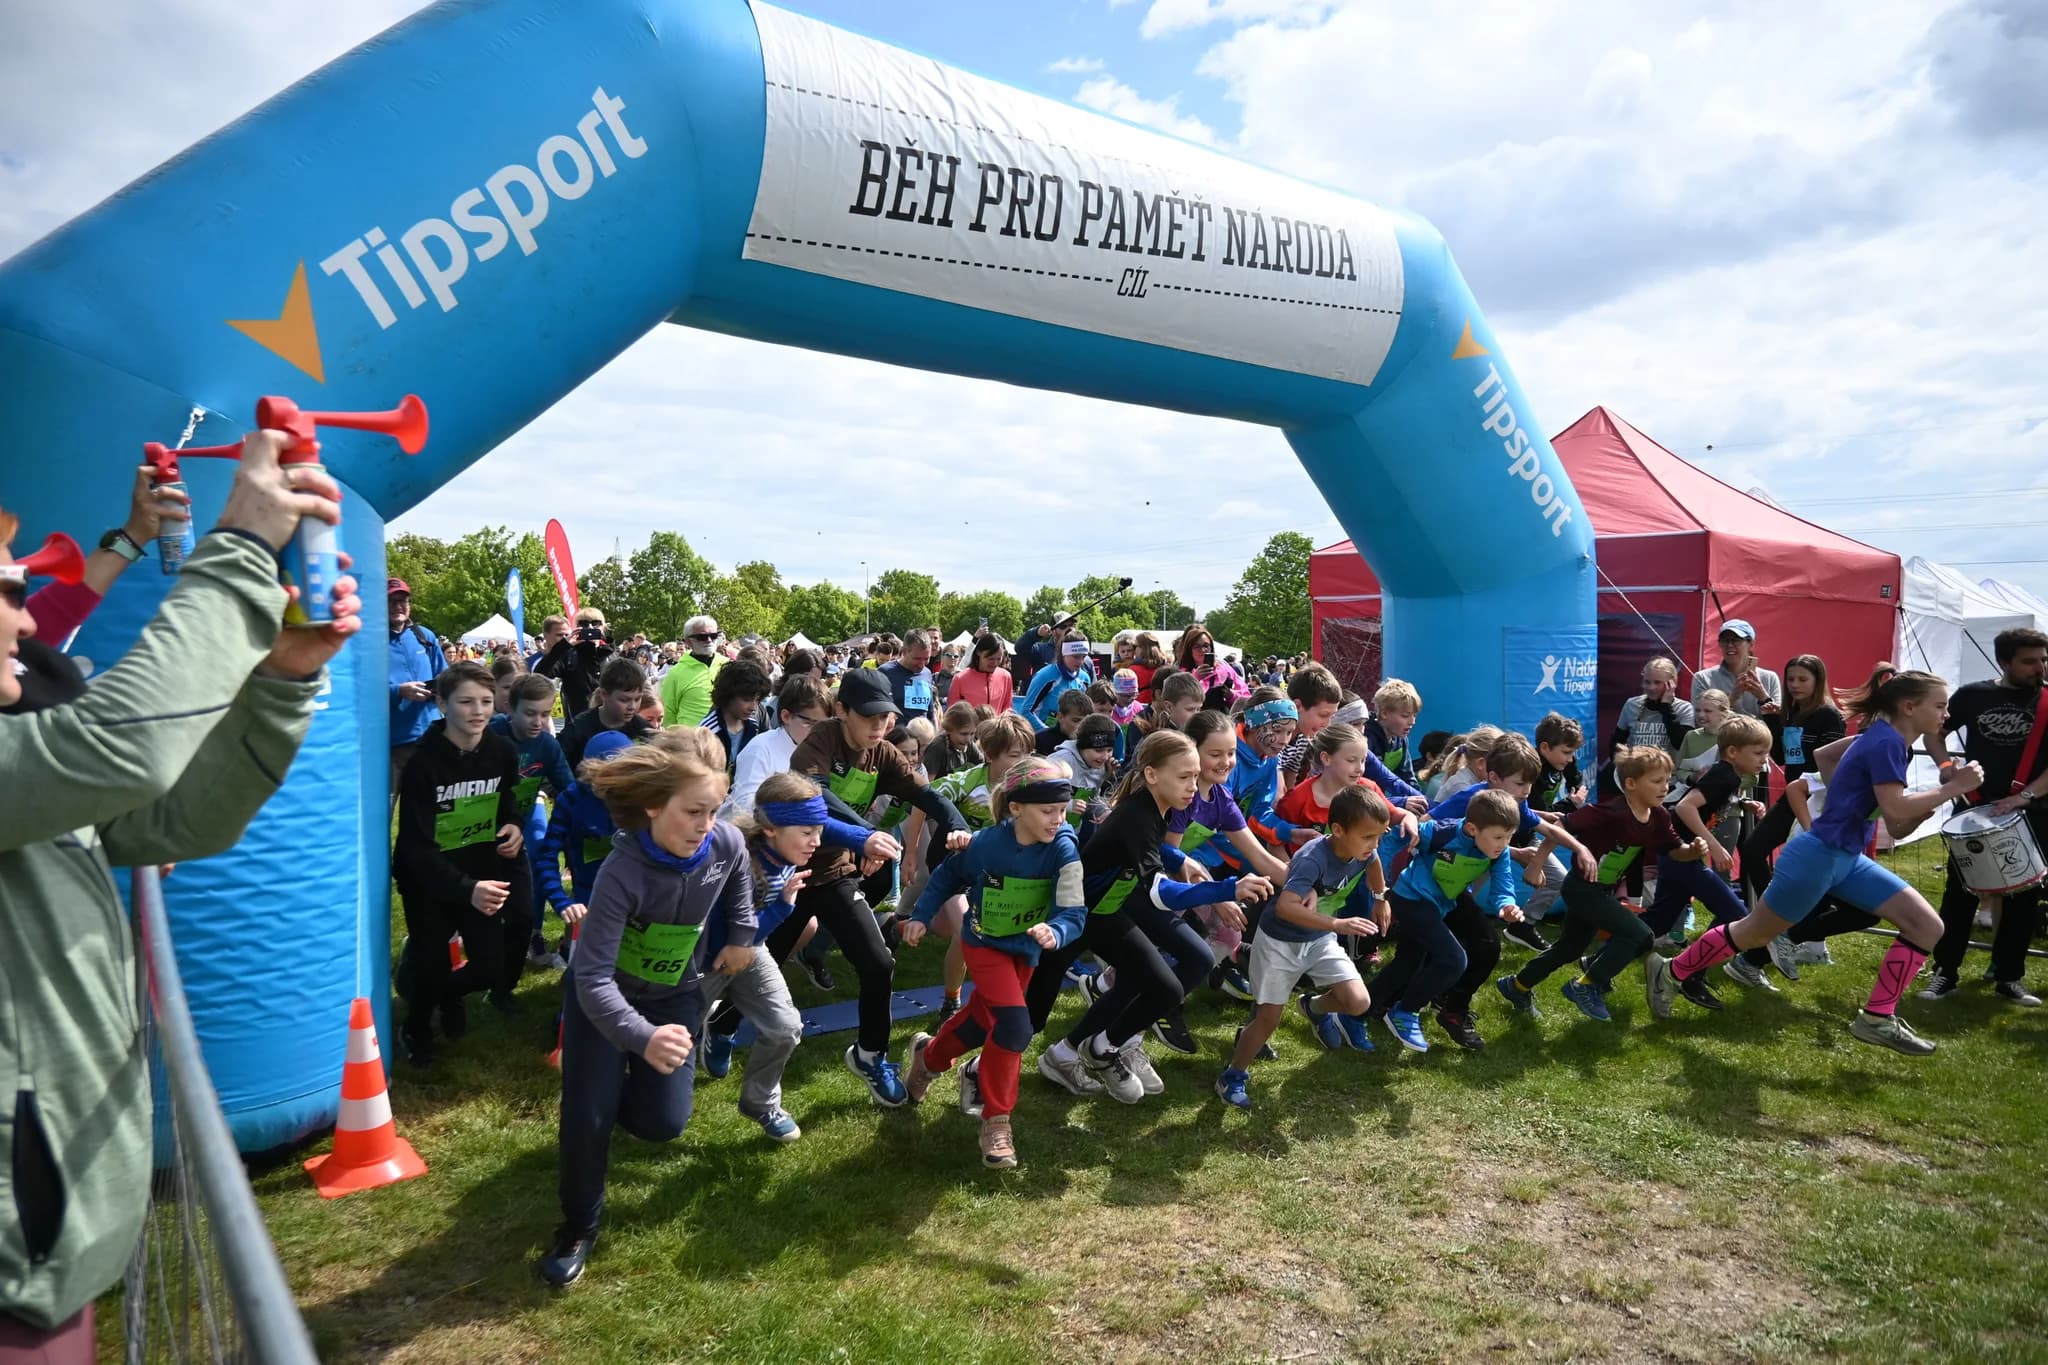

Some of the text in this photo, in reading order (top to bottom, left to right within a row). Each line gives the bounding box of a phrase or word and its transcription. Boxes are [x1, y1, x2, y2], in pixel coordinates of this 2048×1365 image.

[319, 85, 648, 329] Tipsport
[849, 136, 1357, 281] BĚH PRO PAMĚŤ NÁRODA
[1117, 265, 1150, 298] CÍL
[1473, 361, 1572, 538] Tipsport
[1564, 654, 1598, 678] Nada
[436, 776, 502, 803] GAMEDAY
[461, 818, 493, 839] 234
[1012, 904, 1047, 926] 167
[640, 958, 684, 973] 165
